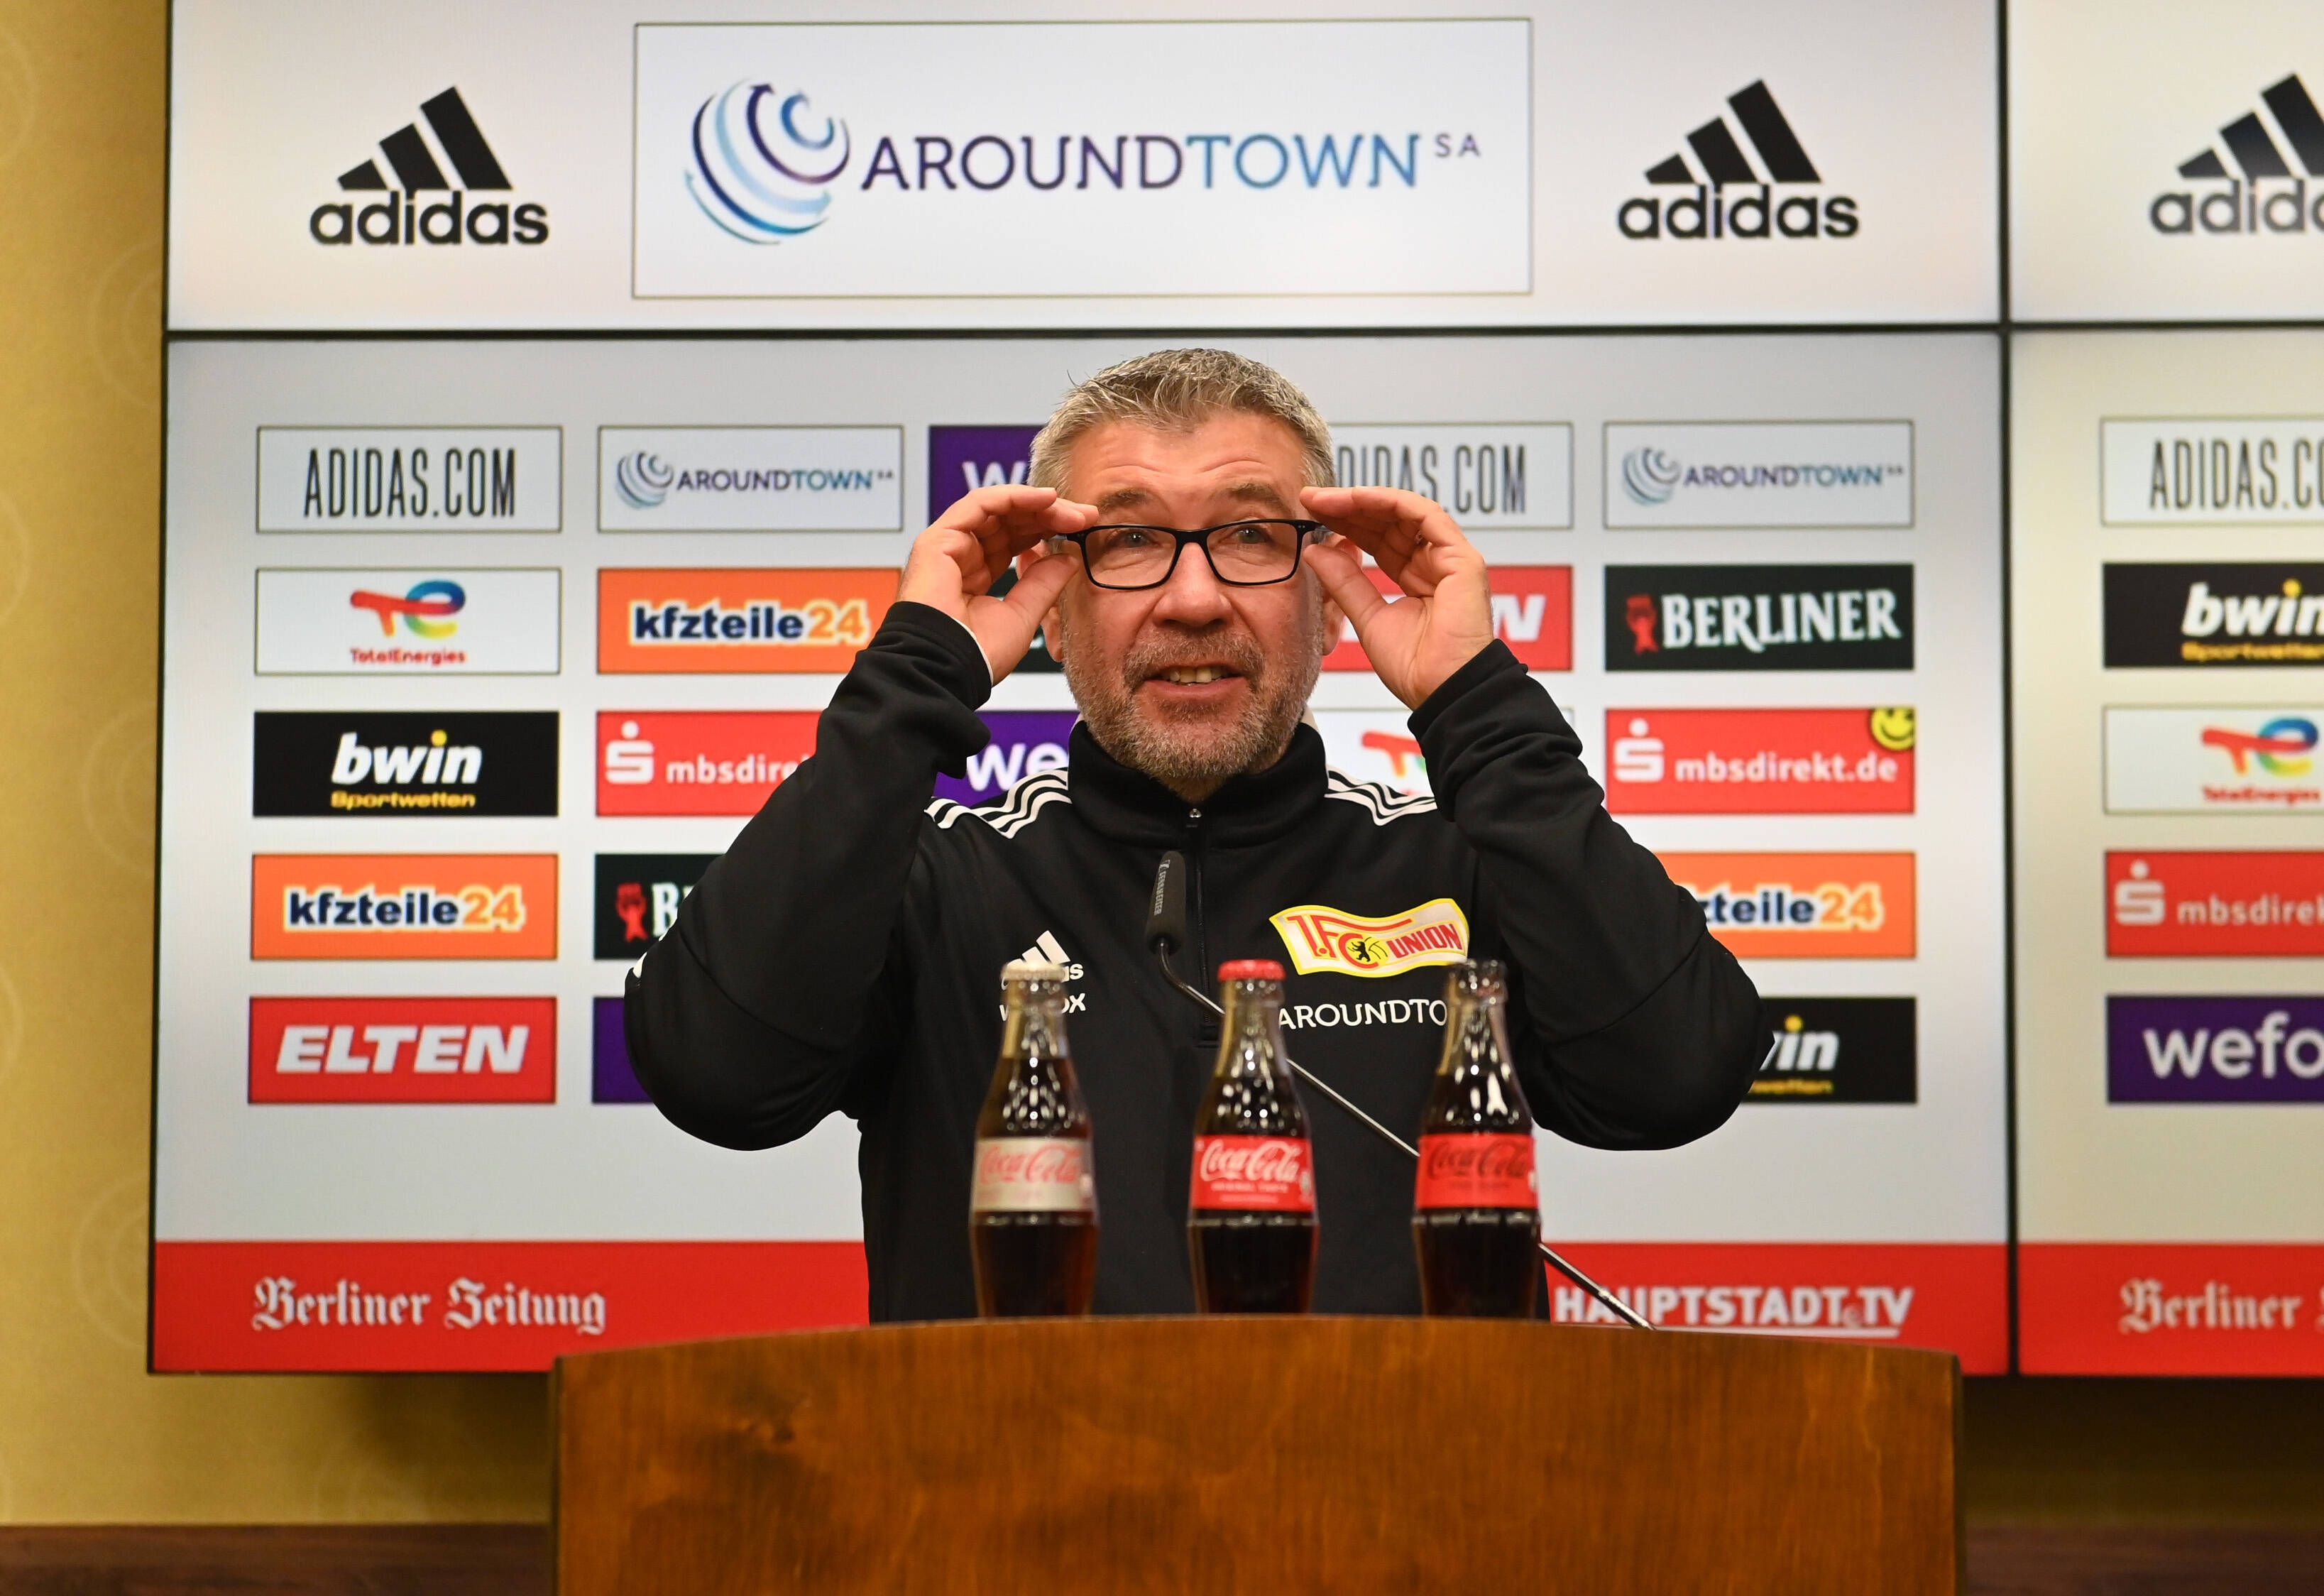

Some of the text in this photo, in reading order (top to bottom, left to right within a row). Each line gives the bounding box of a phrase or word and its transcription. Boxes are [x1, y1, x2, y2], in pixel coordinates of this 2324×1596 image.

[861, 133, 1481, 190] AROUNDTOWN SA
[309, 190, 548, 244] adidas
[1618, 184, 1859, 239] adidas
[304, 447, 516, 518] ADIDAS.COM
[676, 469, 873, 491] AROUNDTOWN
[1337, 444, 1526, 514] DIDAS.COM
[1683, 465, 1884, 488] AROUNDTOWN
[634, 603, 867, 641] kfzteile24
[1661, 589, 1902, 654] BERLINER
[331, 730, 482, 785] bwin
[666, 753, 811, 784] mbsdire
[1675, 750, 1898, 782] mbsdirekt.de
[288, 890, 523, 926] kfzteile24
[1698, 890, 1881, 926] teile24
[1386, 923, 1463, 958] UNION
[276, 1025, 529, 1073] ELTEN
[252, 1276, 607, 1335] Berliner Zeitung
[2119, 1278, 2302, 1333] Berliner
